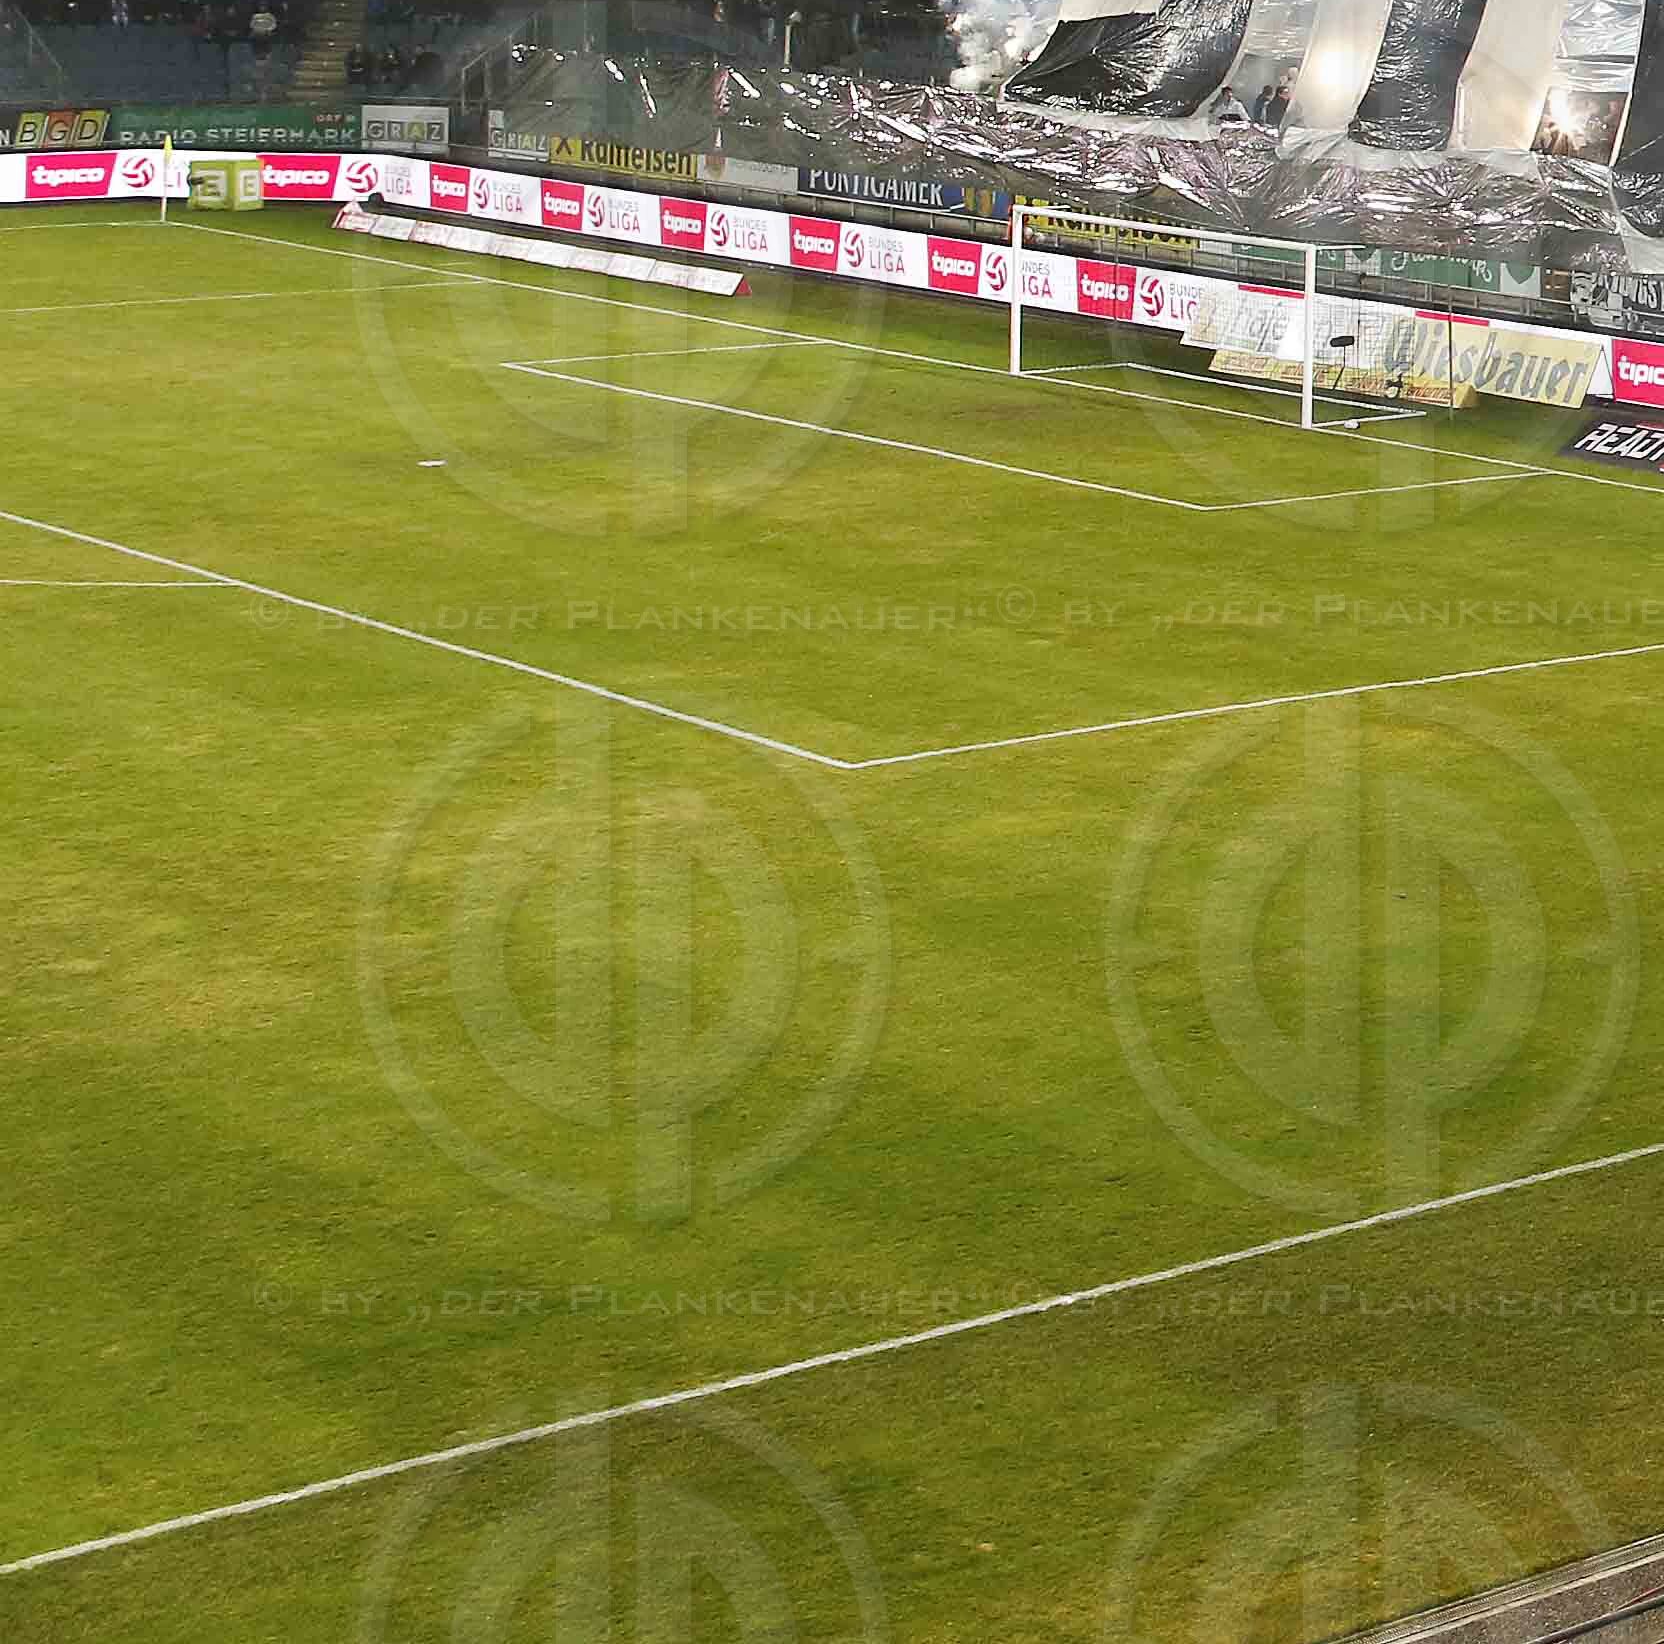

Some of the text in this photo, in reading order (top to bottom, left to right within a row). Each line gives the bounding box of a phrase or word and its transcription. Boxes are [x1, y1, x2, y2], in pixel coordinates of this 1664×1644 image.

[366, 121, 444, 141] GRAZ
[386, 176, 413, 196] LIGA
[432, 175, 466, 200] tipico
[494, 192, 523, 214] LIGA
[544, 192, 580, 219] tipico
[609, 211, 641, 234] LIGA
[663, 210, 702, 236] tipico
[734, 231, 769, 253] LIGA
[793, 232, 836, 258] tipico
[869, 251, 906, 275] LIGA
[932, 251, 976, 278] tipico
[1384, 314, 1589, 404] Wiesbauer
